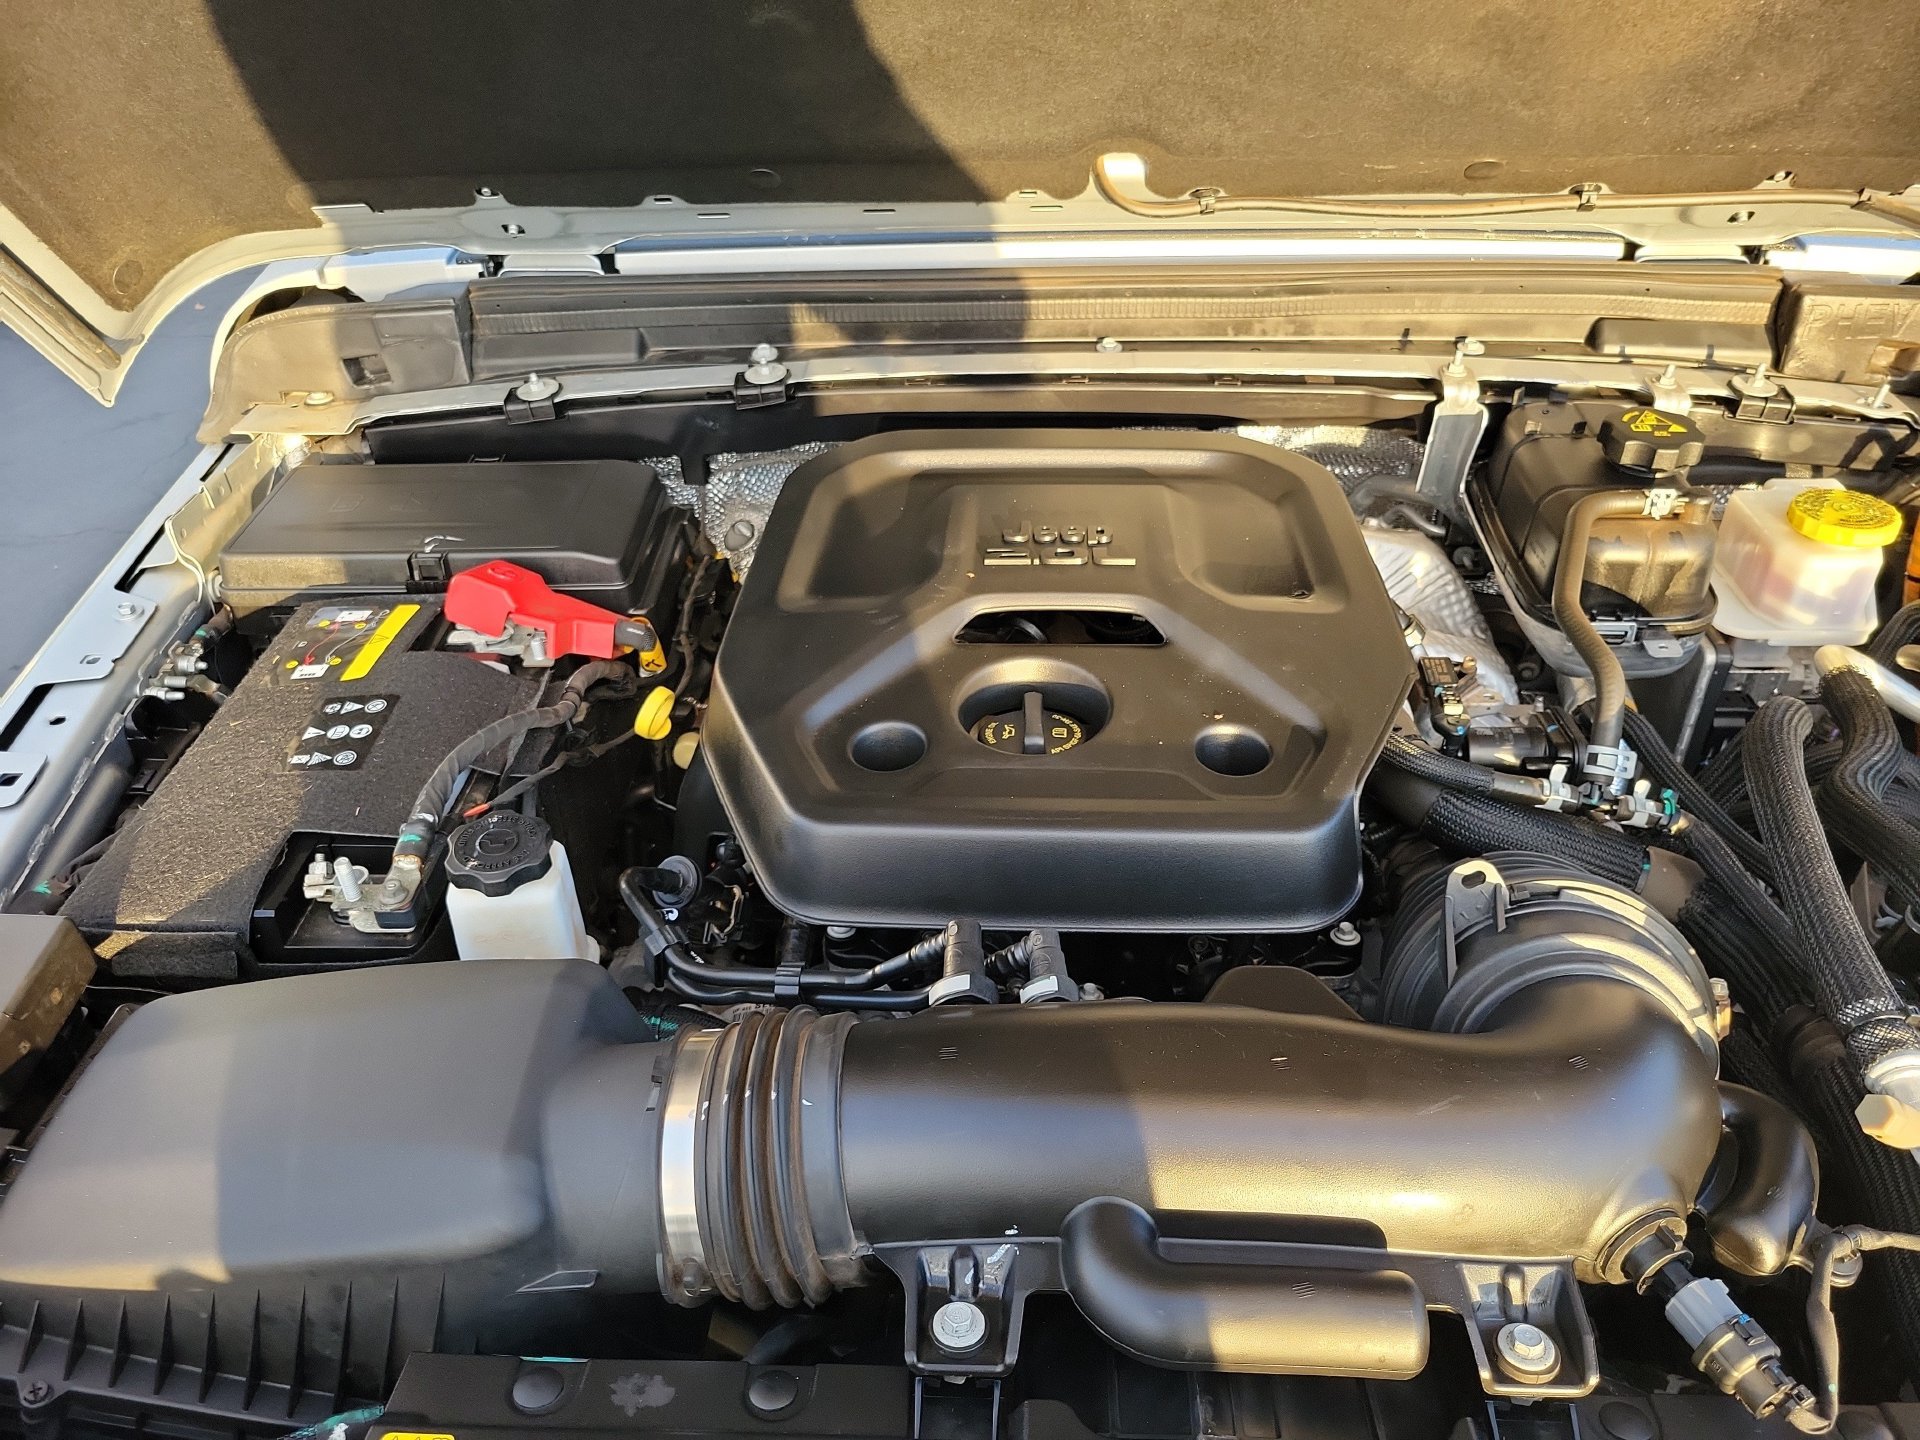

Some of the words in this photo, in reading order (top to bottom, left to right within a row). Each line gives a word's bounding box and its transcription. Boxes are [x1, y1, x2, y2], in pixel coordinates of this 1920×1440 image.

[1801, 303, 1920, 340] PHEV
[1002, 520, 1114, 546] Jeep
[983, 547, 1137, 566] 2.0L
